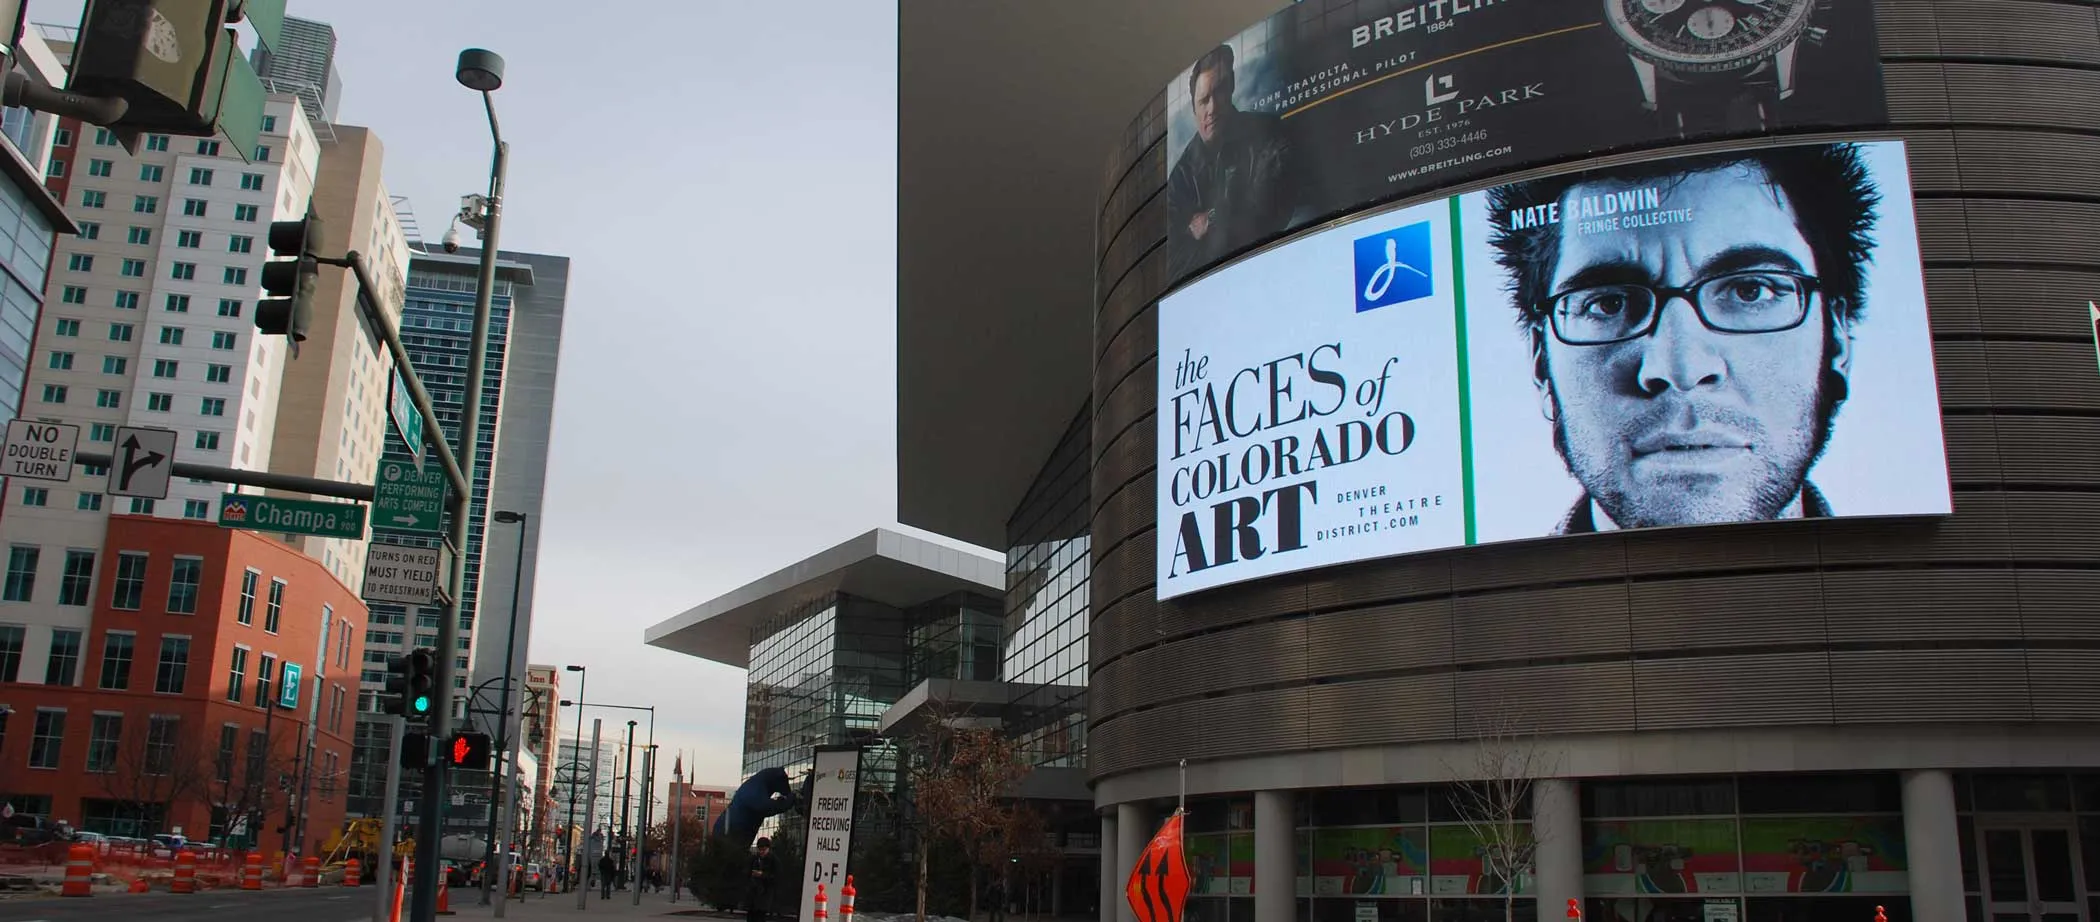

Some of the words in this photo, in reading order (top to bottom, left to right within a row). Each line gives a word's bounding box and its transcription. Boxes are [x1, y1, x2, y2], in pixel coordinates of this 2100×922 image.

[1352, 0, 1506, 49] BREITL
[1427, 18, 1455, 34] 1884
[1253, 91, 1281, 110] JOHN
[1287, 62, 1349, 94] TRAVOLTA
[1275, 67, 1369, 112] PROFESSIONAL
[1375, 50, 1417, 71] PILOT
[1355, 107, 1443, 145] HYDE
[1458, 82, 1545, 114] PARK
[1418, 127, 1443, 138] EST.
[1446, 119, 1472, 131] 1976
[1409, 143, 1435, 160] (303)
[1437, 129, 1488, 151] 333-4446
[1388, 145, 1513, 183] WWW.BREITLING.COM
[1511, 202, 1560, 231] NATE
[1566, 187, 1660, 220] BALDWIN
[1577, 217, 1620, 236] FRINGE
[1622, 208, 1693, 230] COLLECTIVE
[1175, 348, 1209, 390] the
[1170, 342, 1347, 461] FACES
[1355, 357, 1399, 418] of
[26, 424, 59, 443] NO
[8, 443, 69, 462] DOUBLE
[1171, 411, 1416, 507] COLORADO
[16, 460, 58, 476] TURN
[404, 470, 441, 484] DENVER
[380, 482, 440, 498] PERFORMING
[1337, 485, 1387, 504] DENVER
[378, 497, 400, 510] ARTS
[402, 499, 440, 513] COMPLEX
[1358, 495, 1443, 517] THEATRE
[254, 502, 337, 532] Champa
[344, 509, 356, 519] ST
[1168, 480, 1318, 580] ART
[371, 550, 400, 562] TURNS
[402, 553, 415, 563] ON
[417, 555, 435, 565] RED
[369, 565, 398, 579] MUST
[403, 568, 433, 582] YIELD
[367, 583, 376, 592] TO
[379, 584, 430, 597] PEDESTRIANS
[817, 797, 849, 812] FREIGHT
[811, 816, 850, 832] RECEIVING
[816, 836, 841, 852] HALLS
[813, 861, 823, 882] D
[830, 862, 839, 884] F
